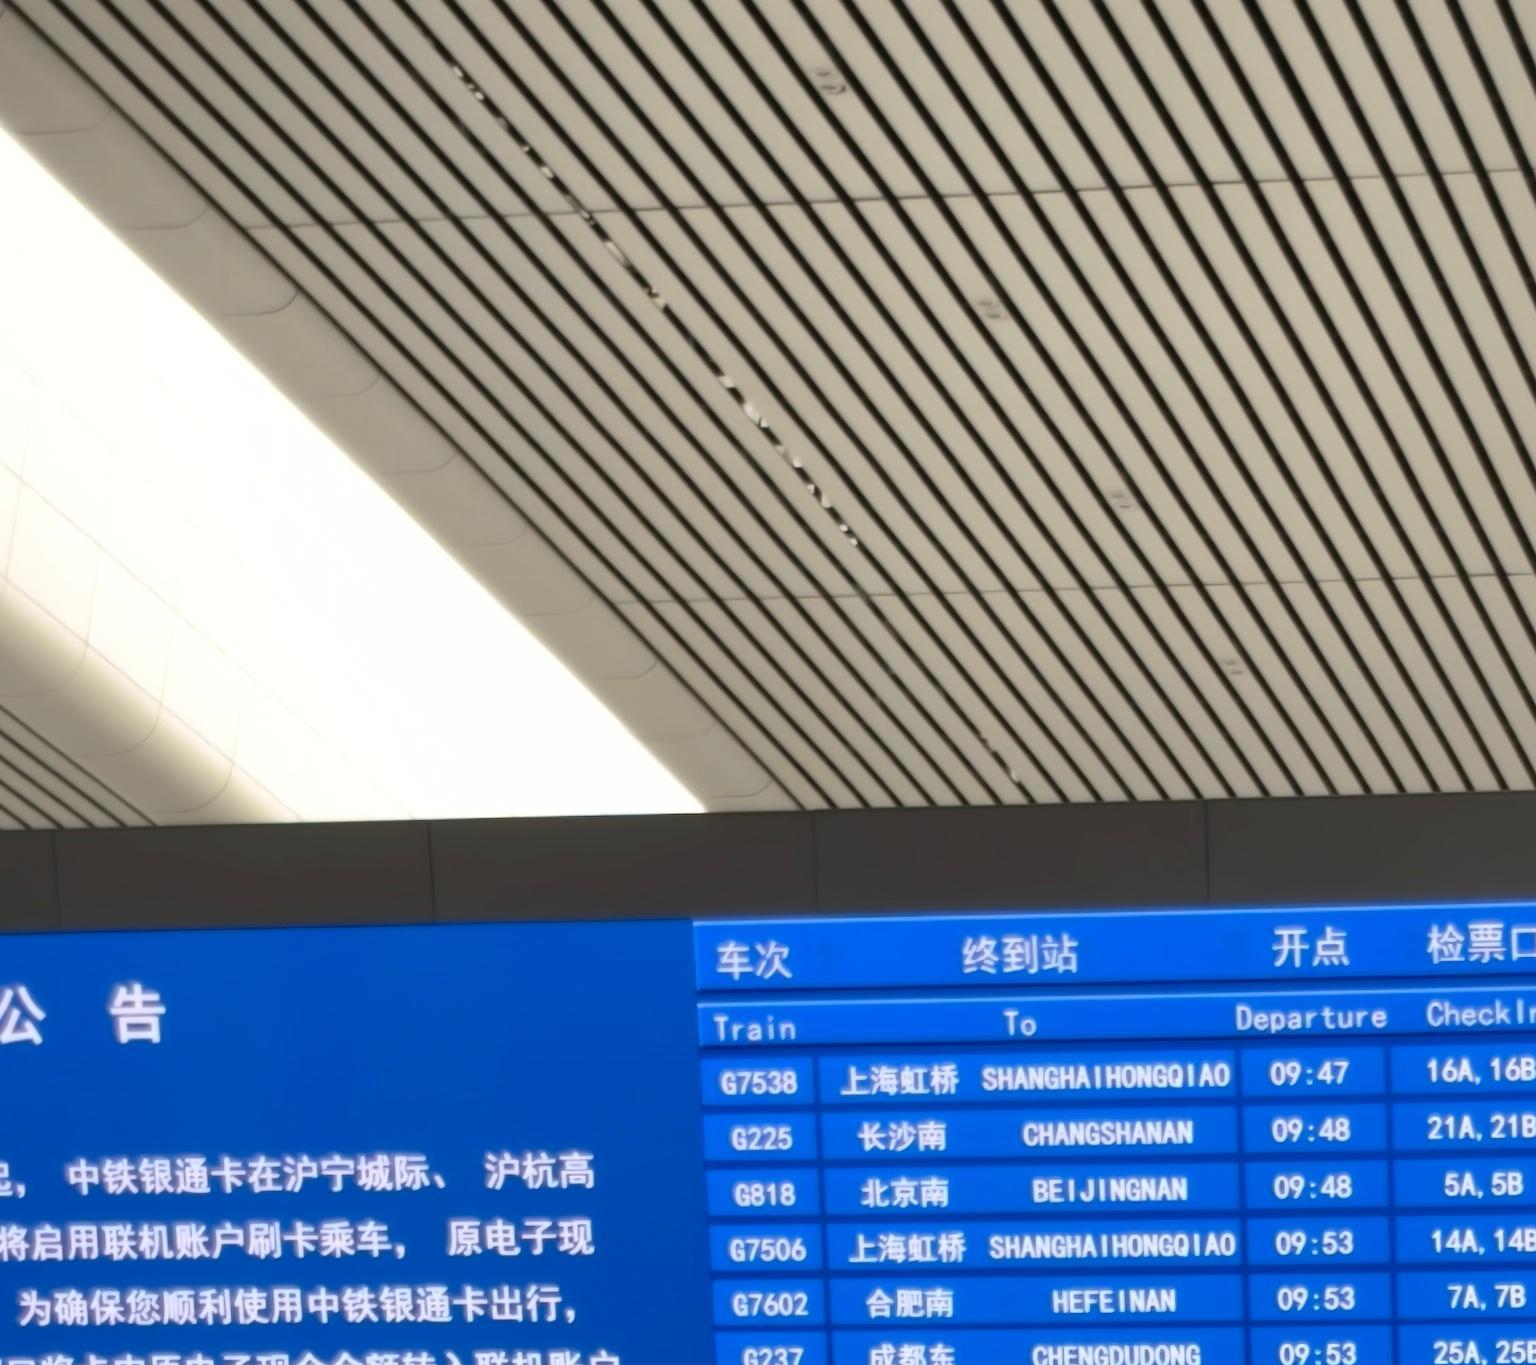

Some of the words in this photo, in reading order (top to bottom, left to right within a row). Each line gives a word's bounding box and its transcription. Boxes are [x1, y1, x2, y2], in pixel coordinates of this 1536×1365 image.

[718, 941, 791, 980] 车次
[963, 934, 1077, 973] 终到站
[1273, 927, 1349, 967] 开点
[0, 983, 165, 1044] 公告
[714, 1015, 795, 1041] Train
[1004, 1009, 1036, 1035] To
[1236, 1004, 1386, 1033] Departure
[721, 1071, 797, 1095] G7538
[841, 1064, 958, 1095] 上海虹桥
[983, 1063, 1230, 1090] SHANGHAIHONGQIAO
[1270, 1061, 1349, 1085] 09:47
[732, 1126, 792, 1150] G225
[858, 1121, 945, 1151] 长沙南
[1023, 1121, 1192, 1146] CHANGSHANAN
[1272, 1117, 1350, 1142] 09:48
[734, 1183, 795, 1206] G818
[862, 1177, 948, 1207] 北京南
[1033, 1178, 1187, 1202] BEIJINGNAN
[1274, 1174, 1352, 1199] 09:48
[730, 1238, 806, 1261] G7506
[850, 1233, 965, 1263] 上海虹桥
[990, 1233, 1235, 1258] SHANGHAIHONGQIAO
[1276, 1231, 1353, 1255] 09:53
[733, 1292, 807, 1316] G7602
[867, 1288, 952, 1318] 合肥南
[1053, 1289, 1175, 1313] HEFEINAN
[1278, 1286, 1354, 1310] 09:53
[1279, 1342, 1356, 1365] 09:53
